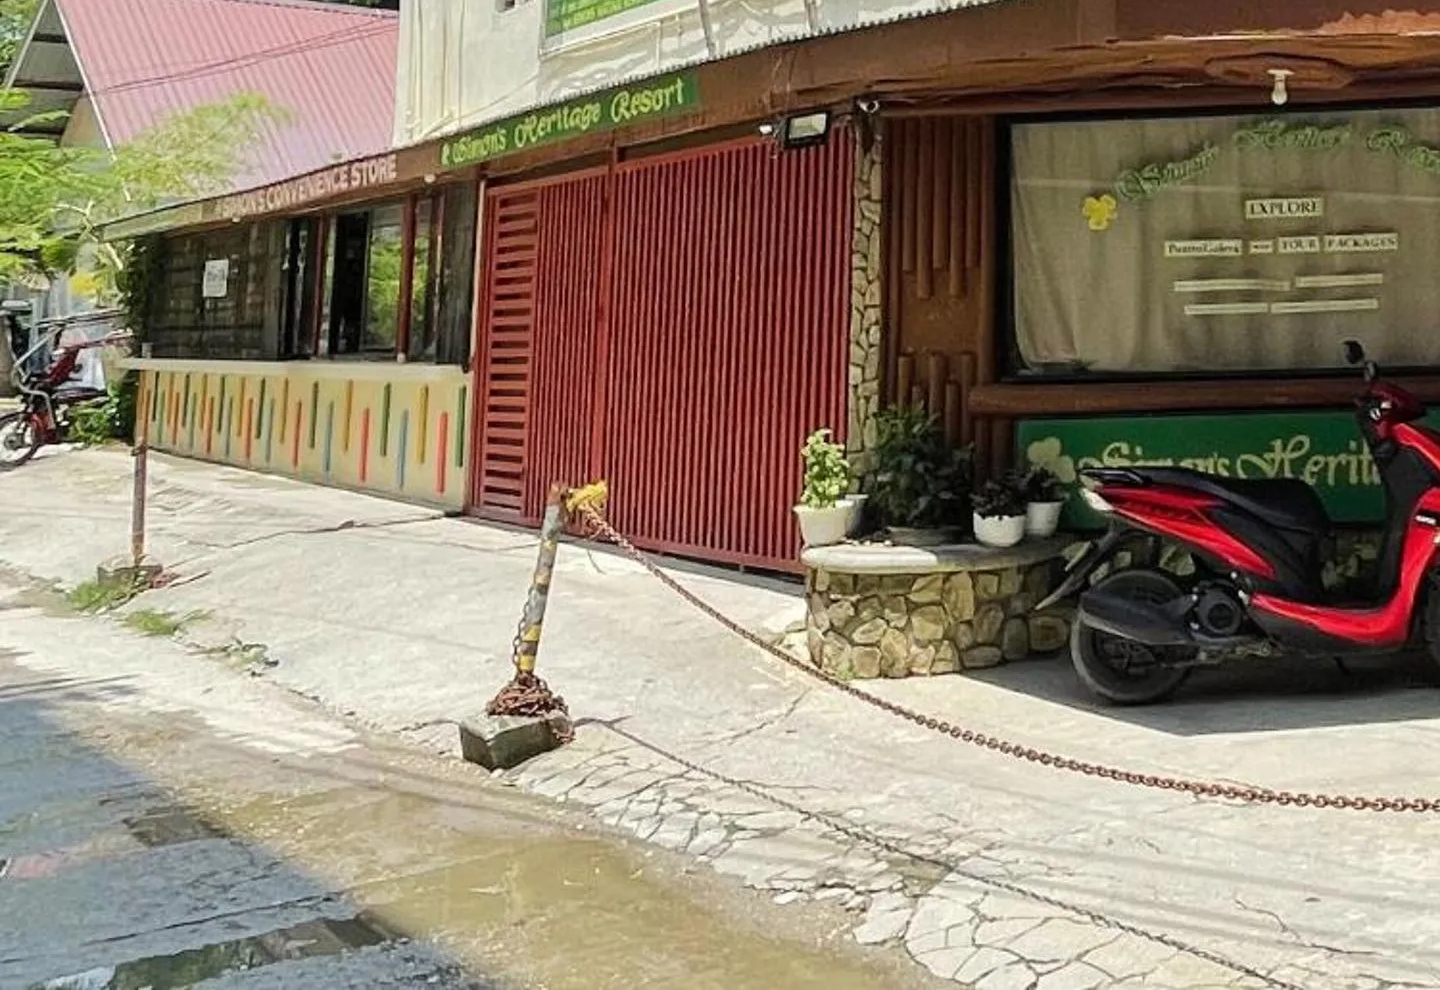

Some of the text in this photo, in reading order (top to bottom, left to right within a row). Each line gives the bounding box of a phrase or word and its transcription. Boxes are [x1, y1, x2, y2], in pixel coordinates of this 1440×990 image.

[611, 77, 684, 123] Resort
[351, 154, 397, 186] STORE
[1249, 200, 1317, 216] EXPLORE
[1236, 434, 1382, 486] Herit
